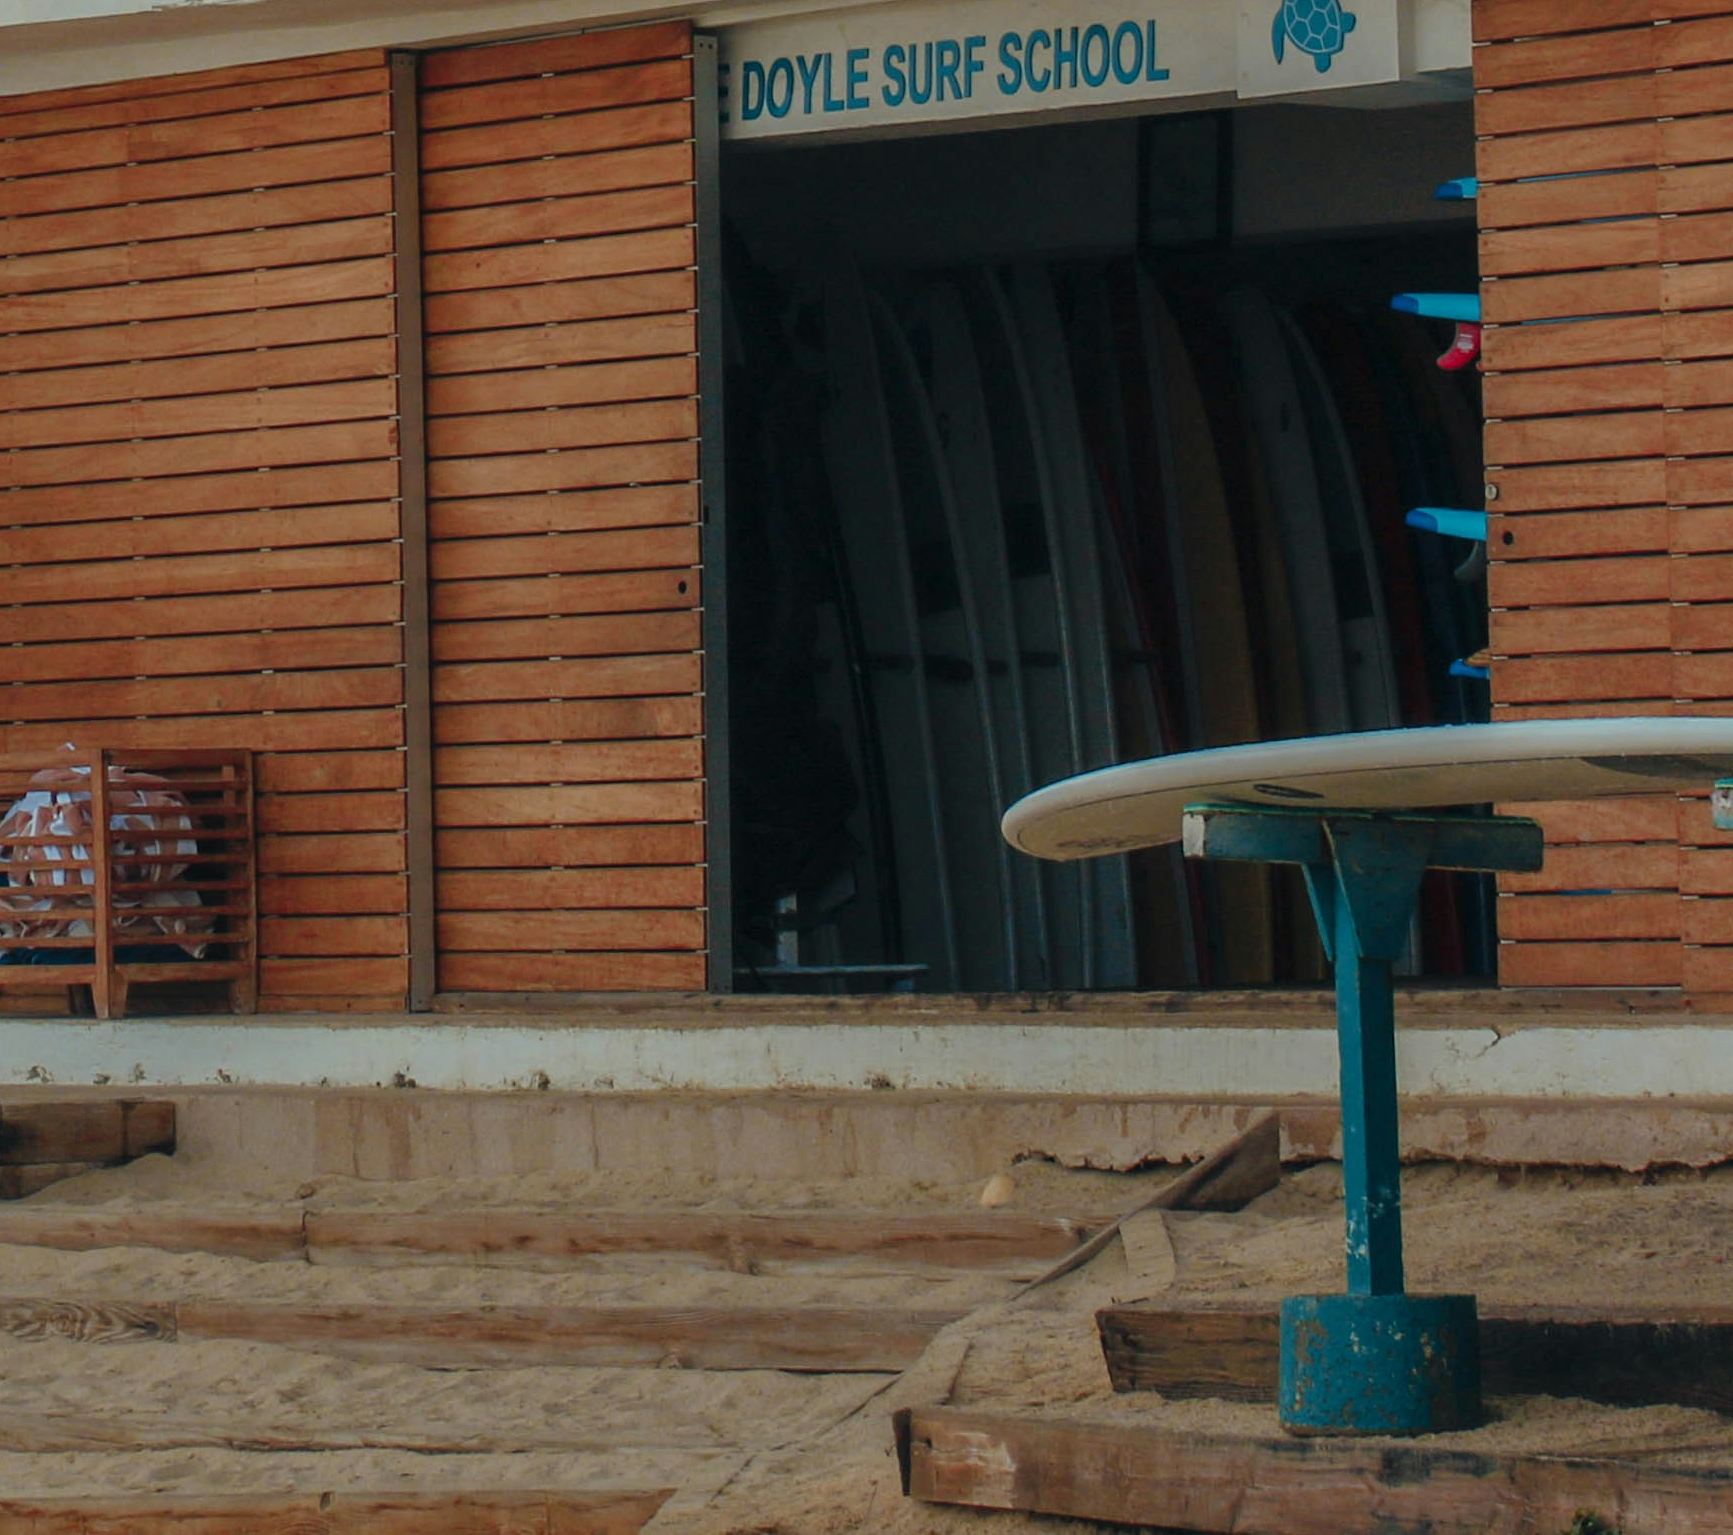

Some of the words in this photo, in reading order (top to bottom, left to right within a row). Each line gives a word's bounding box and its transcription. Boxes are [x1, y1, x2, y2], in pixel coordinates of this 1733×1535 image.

[741, 48, 869, 121] DOYLE
[882, 35, 985, 107] SURF
[997, 19, 1170, 95] SCHOOL
